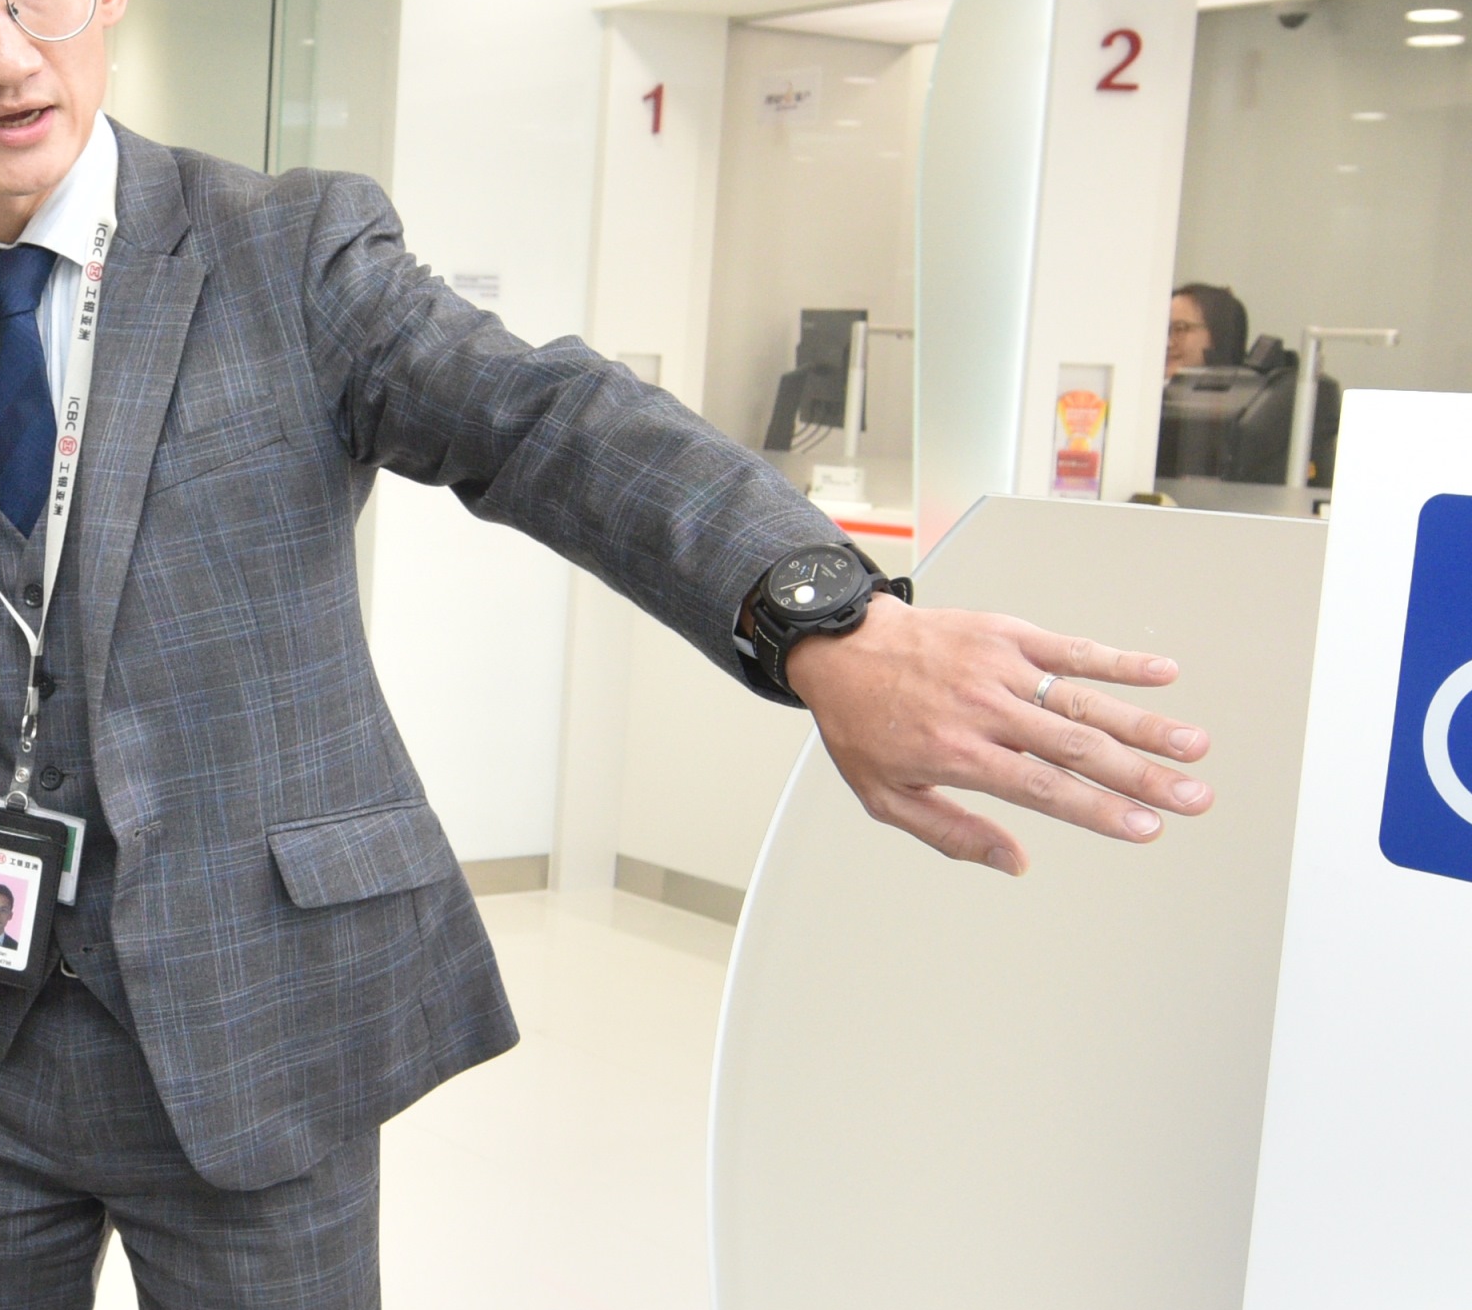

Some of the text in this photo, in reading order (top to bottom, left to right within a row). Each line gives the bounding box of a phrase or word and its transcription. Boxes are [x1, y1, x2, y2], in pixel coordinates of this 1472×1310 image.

[1096, 28, 1144, 93] 2
[642, 83, 665, 135] 1
[91, 221, 108, 257] ICBC
[65, 396, 81, 432] ICBC
[834, 558, 848, 571] 12
